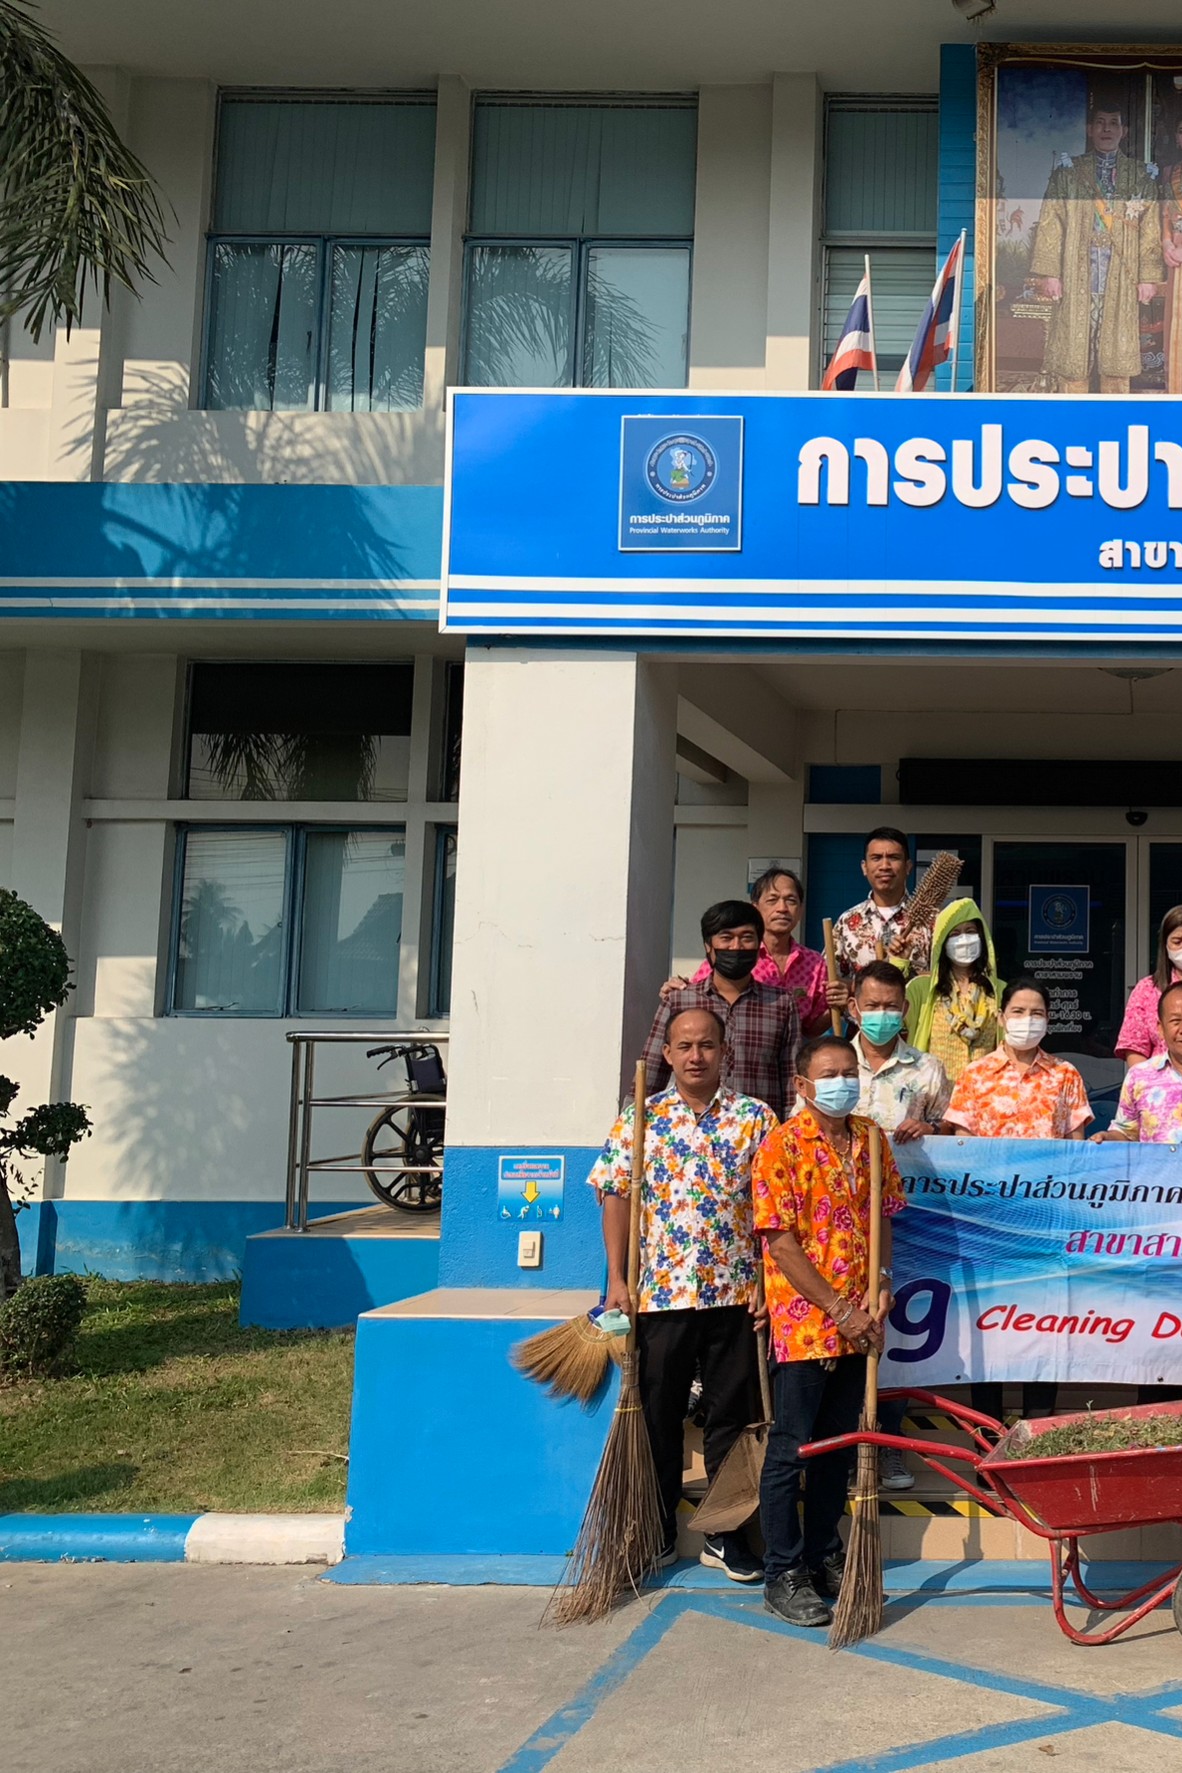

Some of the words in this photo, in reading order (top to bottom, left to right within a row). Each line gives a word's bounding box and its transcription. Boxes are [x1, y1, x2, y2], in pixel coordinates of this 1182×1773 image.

[629, 513, 731, 526] การประปาส่วนภูมิภาค
[700, 527, 730, 536] Authority
[976, 1304, 1136, 1344] Cleaning
